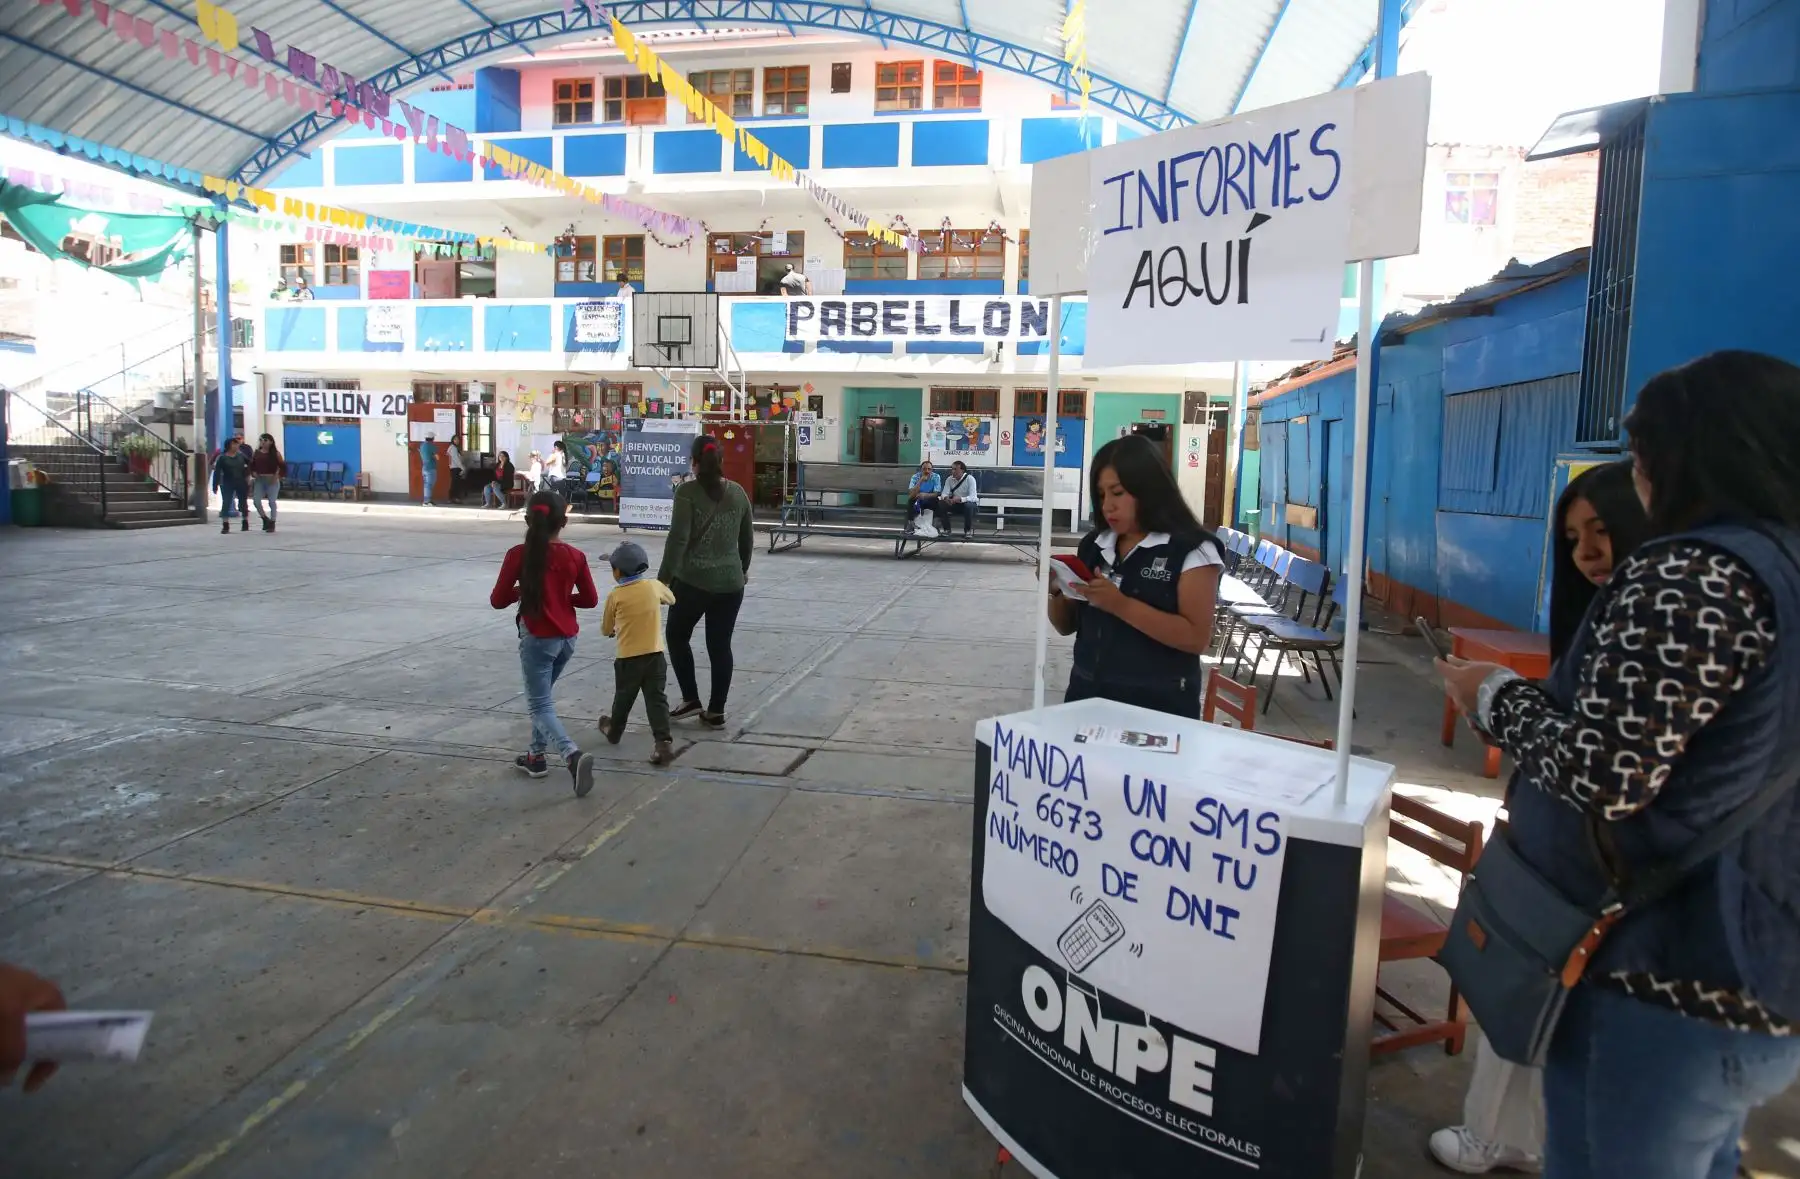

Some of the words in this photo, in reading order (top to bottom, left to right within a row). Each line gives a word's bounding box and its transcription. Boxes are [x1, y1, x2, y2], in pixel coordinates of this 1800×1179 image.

[1103, 123, 1341, 235] INFORMES
[1122, 212, 1272, 309] AQUÍ
[382, 394, 414, 416] 20
[625, 442, 681, 453] ¡BIENVENIDO
[625, 454, 631, 463] A
[632, 454, 645, 463] TU
[646, 455, 674, 464] LOCAL
[675, 456, 687, 465] DE
[625, 465, 670, 476] VOTACIÓN!
[1141, 567, 1171, 581] ONPE
[991, 770, 1018, 807] AL
[1036, 793, 1103, 841] 6673
[1130, 829, 1191, 872] CON
[1212, 852, 1257, 890] TU
[993, 721, 1088, 800] MANDA
[1123, 774, 1167, 823] UN
[1189, 797, 1282, 856] SMS
[989, 811, 1079, 878] NÚMERO
[1101, 863, 1139, 903] DE
[1166, 886, 1240, 941] DNI
[994, 1003, 1027, 1038] OFICINA
[1027, 1029, 1079, 1076] NACIONAL
[1081, 1069, 1096, 1085] DE
[1099, 1079, 1162, 1120] PROCESOS
[1165, 1112, 1261, 1158] ELECTORALES
[1021, 964, 1216, 1117] ONPE
